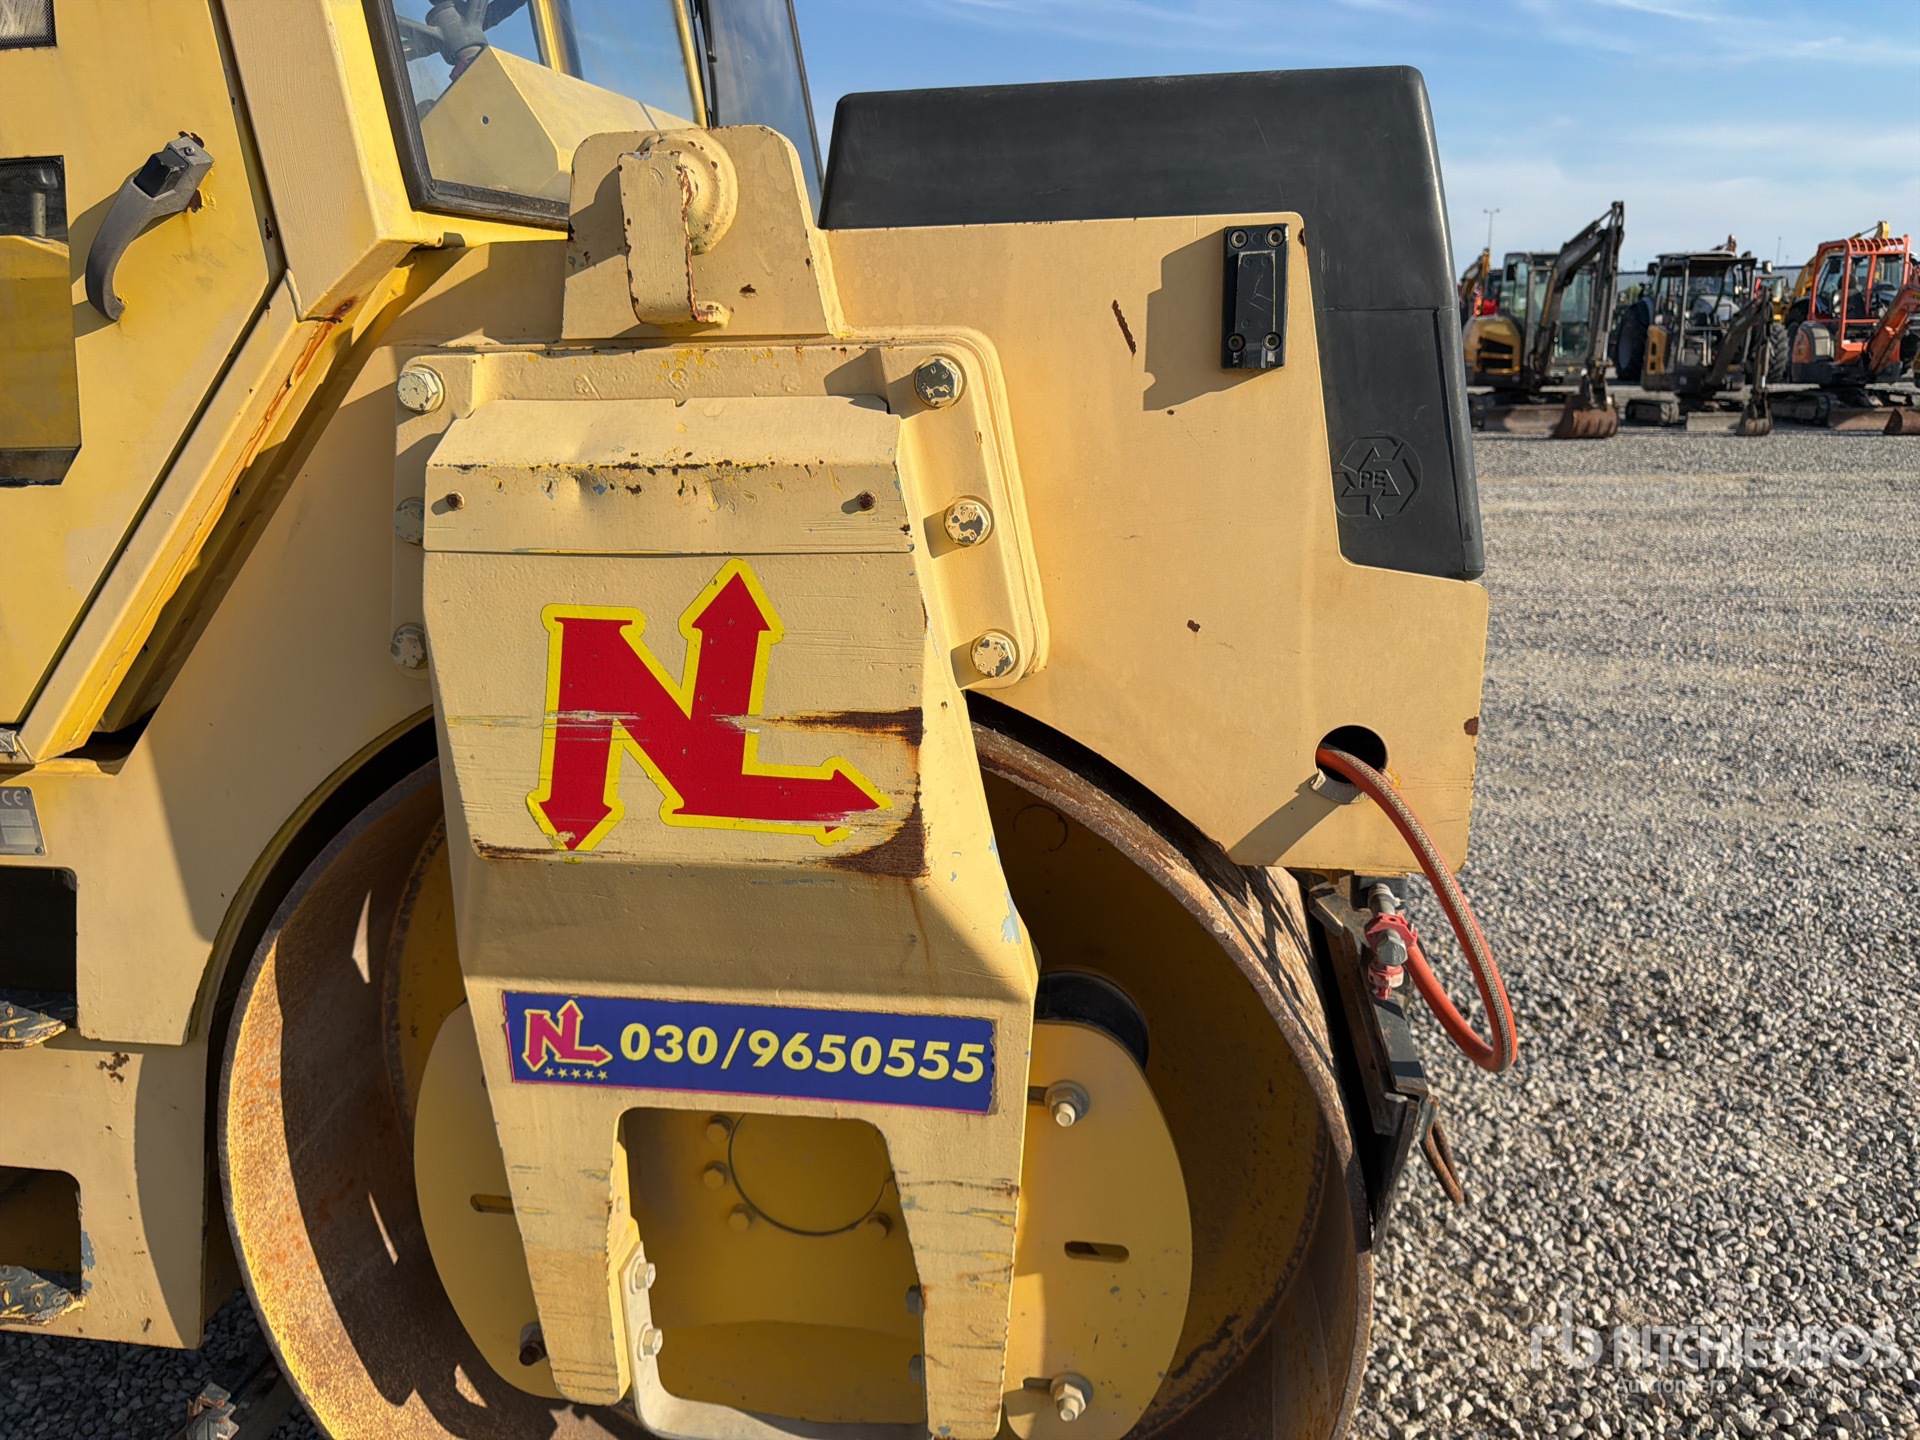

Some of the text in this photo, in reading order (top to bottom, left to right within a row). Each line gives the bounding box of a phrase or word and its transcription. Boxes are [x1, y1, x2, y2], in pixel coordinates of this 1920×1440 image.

[1359, 470, 1387, 489] PE
[1, 789, 24, 806] CE
[619, 1022, 986, 1083] 030/9650555
